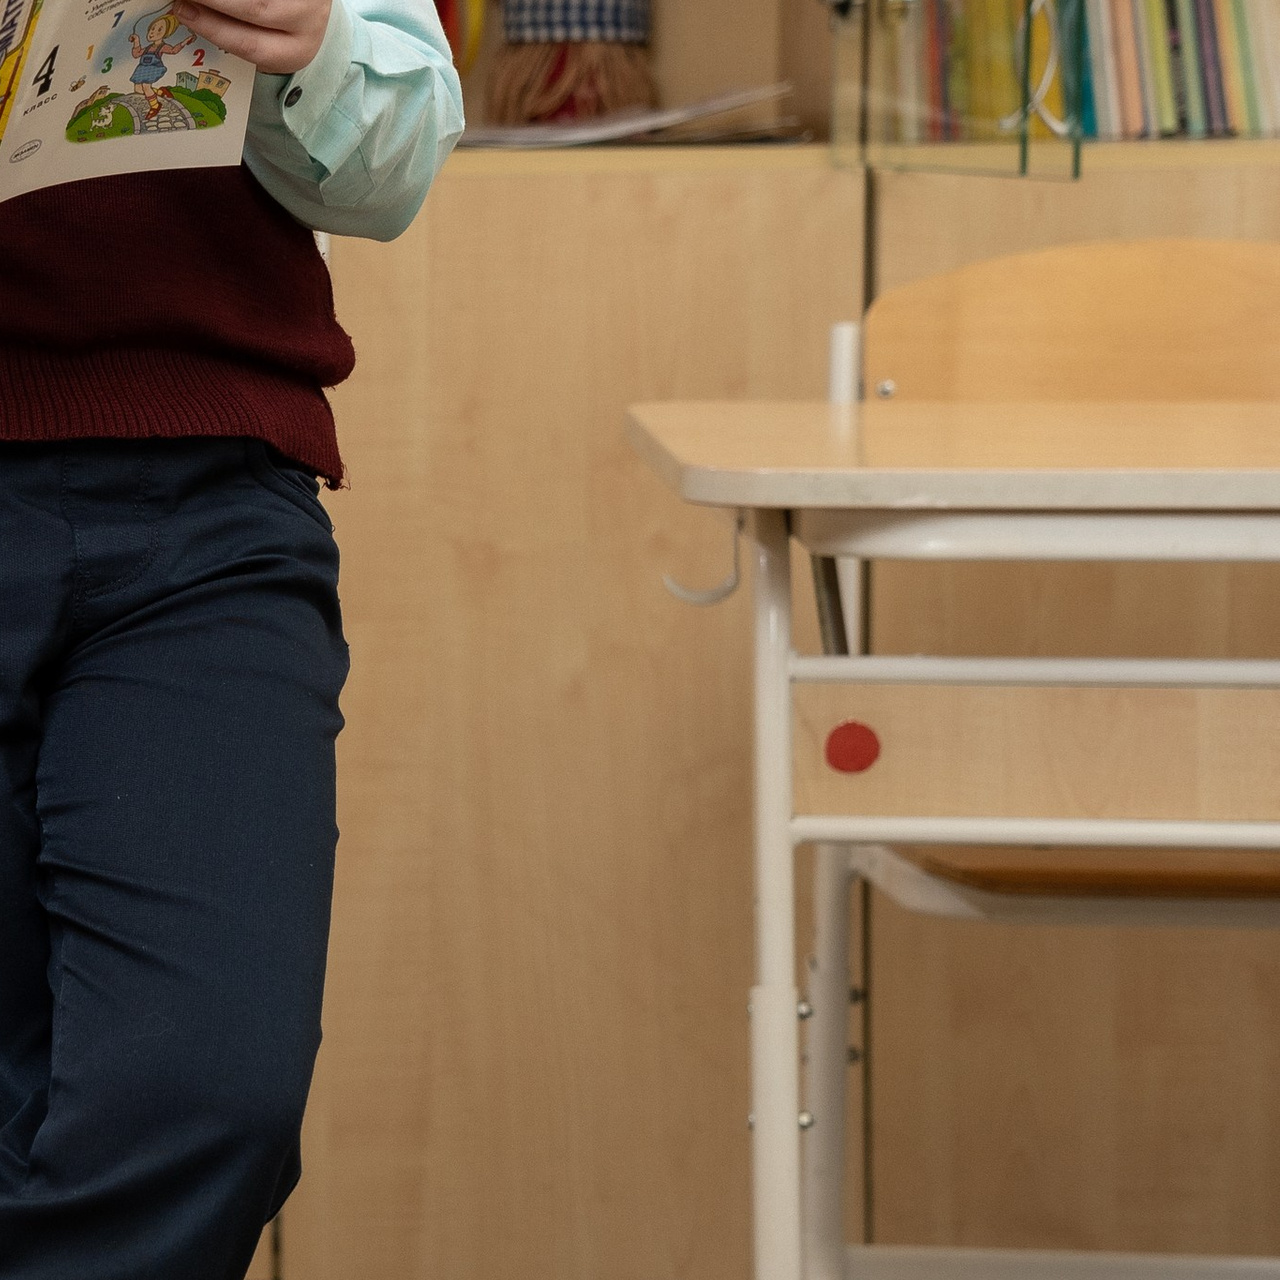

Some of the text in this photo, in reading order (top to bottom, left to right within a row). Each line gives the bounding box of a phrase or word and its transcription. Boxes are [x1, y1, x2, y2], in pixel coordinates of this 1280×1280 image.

[112, 10, 125, 29] 7
[86, 44, 94, 61] 1
[192, 49, 205, 67] 2
[32, 44, 60, 98] 4
[101, 56, 114, 74] 3
[23, 92, 58, 117] класс
